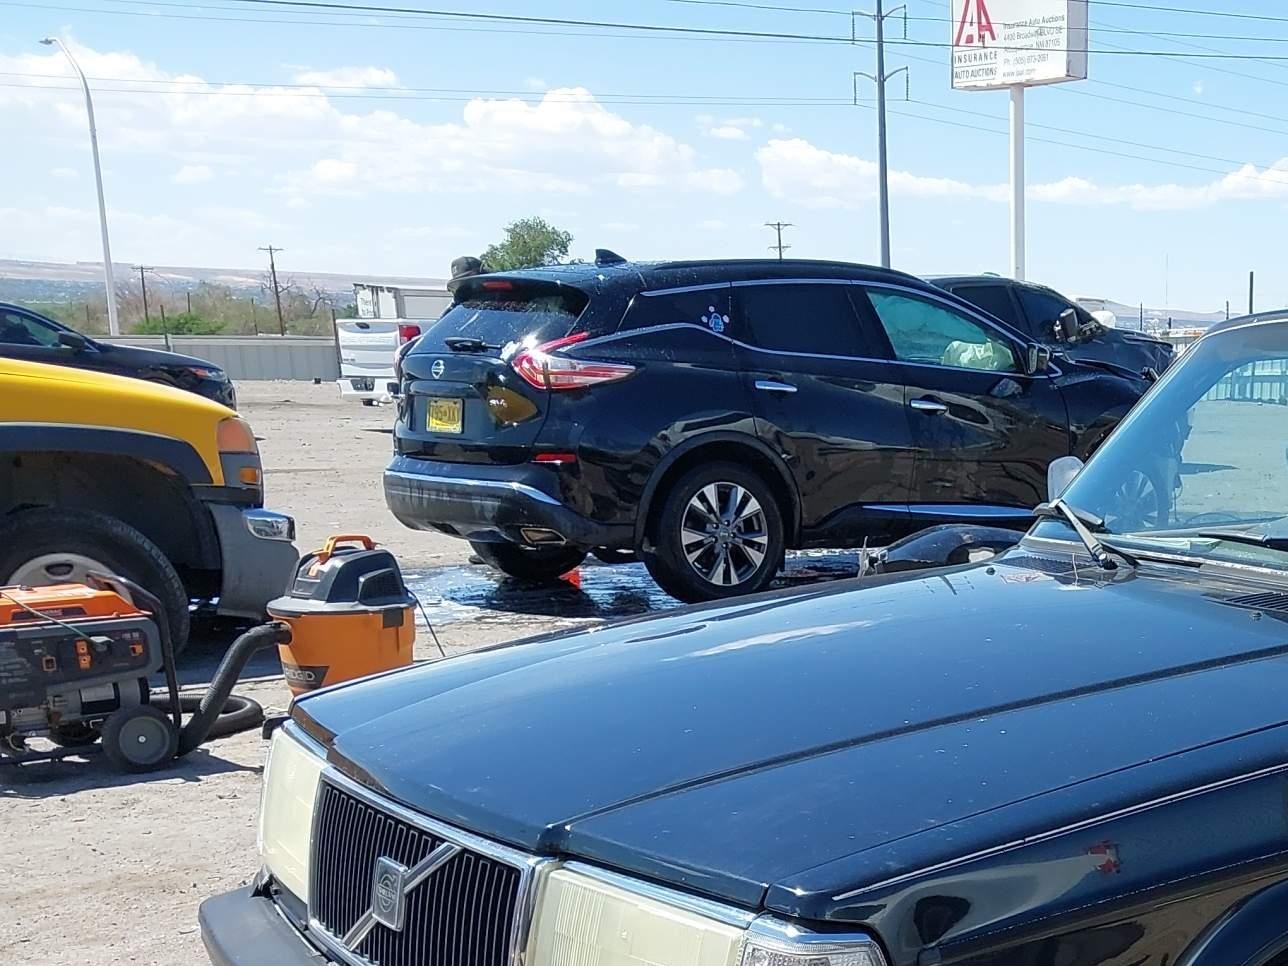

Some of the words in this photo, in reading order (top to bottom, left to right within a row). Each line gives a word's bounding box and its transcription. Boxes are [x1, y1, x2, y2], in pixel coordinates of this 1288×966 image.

[954, 51, 997, 65] INSURANCE
[954, 69, 969, 80] AUTO
[970, 66, 997, 78] AUCTIONS
